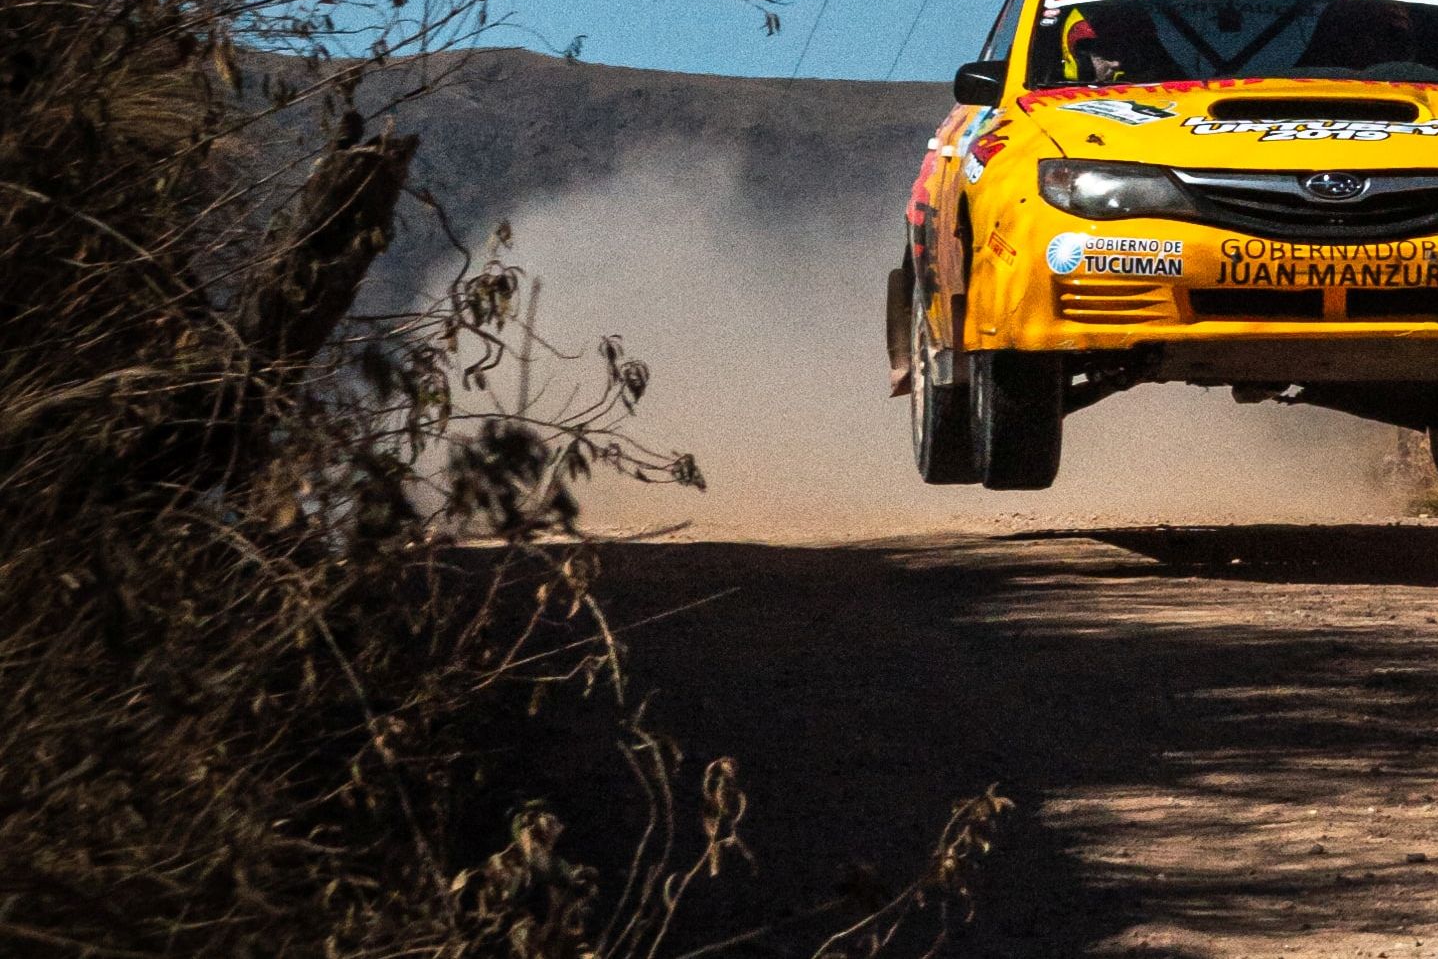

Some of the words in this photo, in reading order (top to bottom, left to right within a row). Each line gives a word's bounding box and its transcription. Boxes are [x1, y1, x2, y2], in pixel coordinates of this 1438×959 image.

[1258, 129, 1391, 142] 2019
[1085, 238, 1159, 252] GOBIERNO
[1164, 240, 1182, 253] DE
[1216, 260, 1296, 285] JUAN
